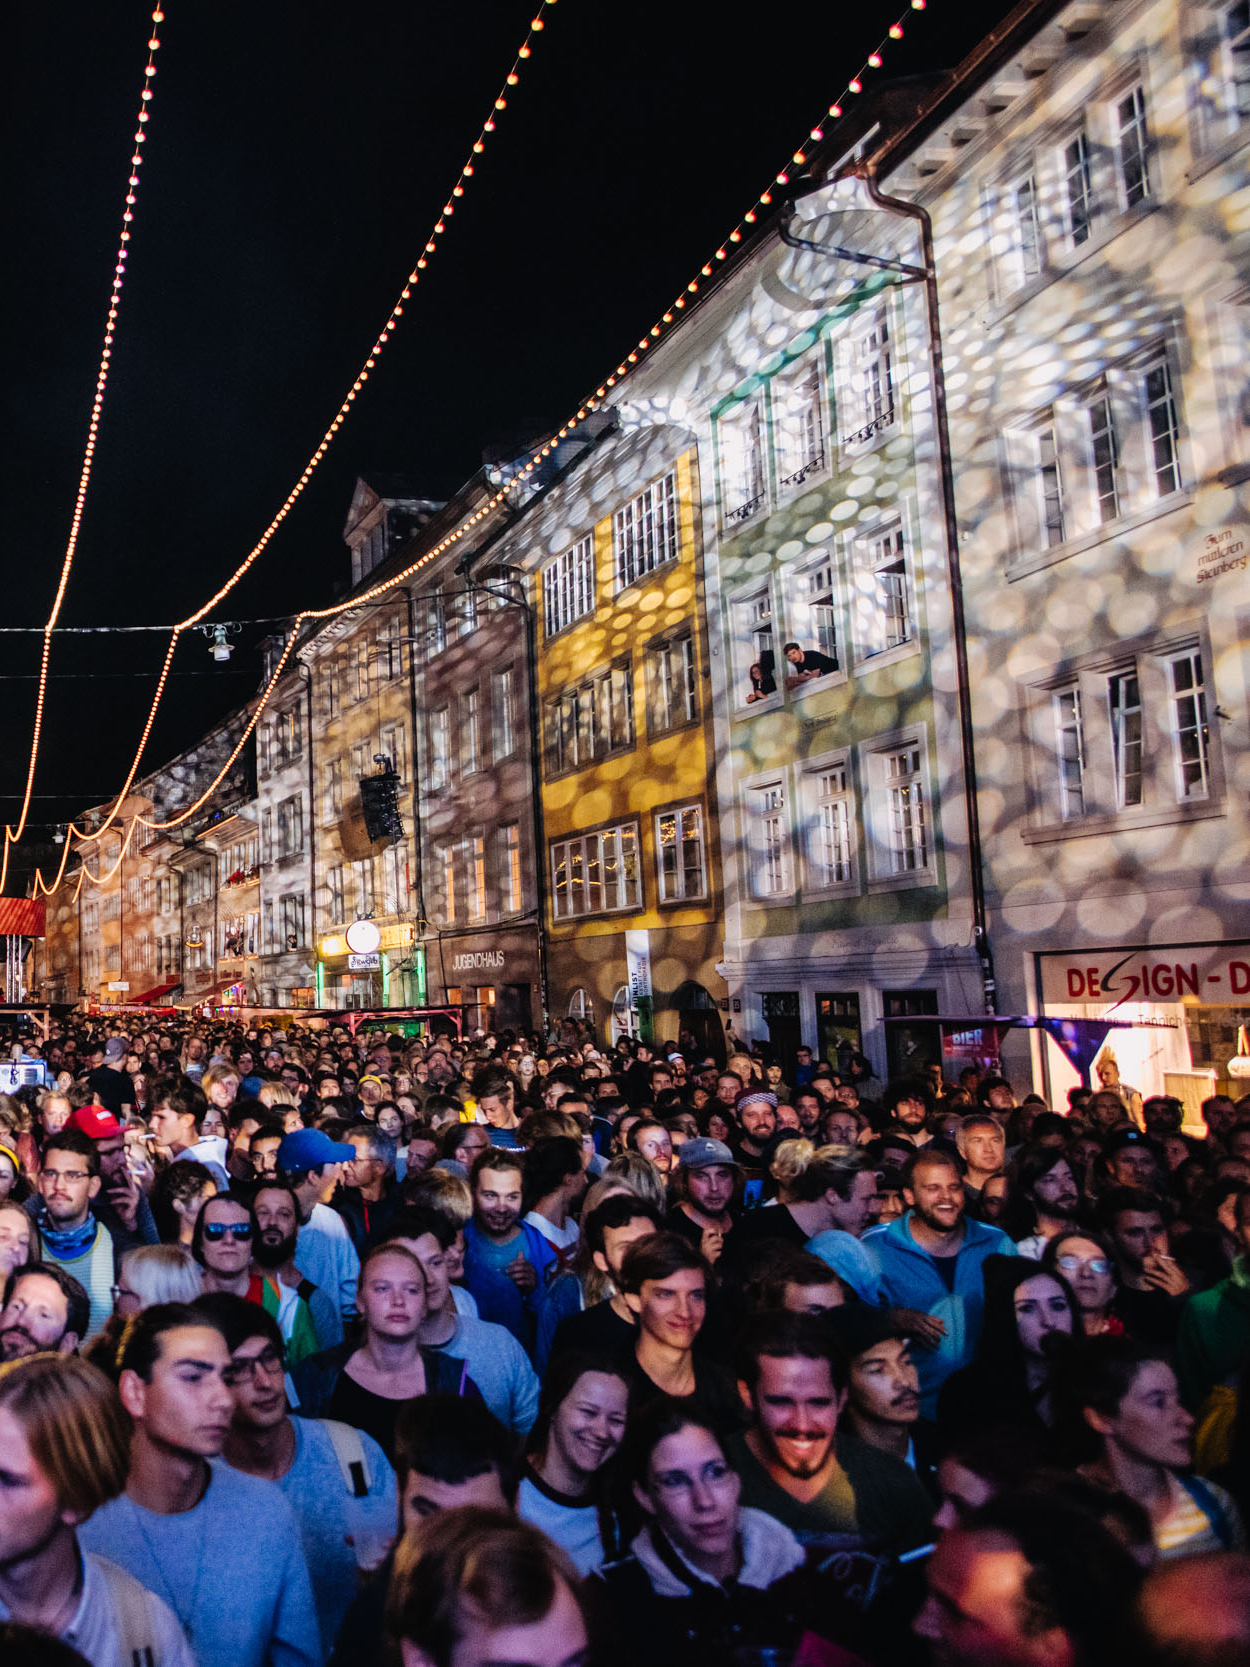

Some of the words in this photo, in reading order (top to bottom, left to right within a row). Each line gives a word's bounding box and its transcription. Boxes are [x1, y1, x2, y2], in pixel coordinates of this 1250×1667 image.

[452, 950, 505, 970] JUGENDHAUS
[1067, 953, 1200, 1013] DESIGN
[952, 1029, 983, 1045] BIER
